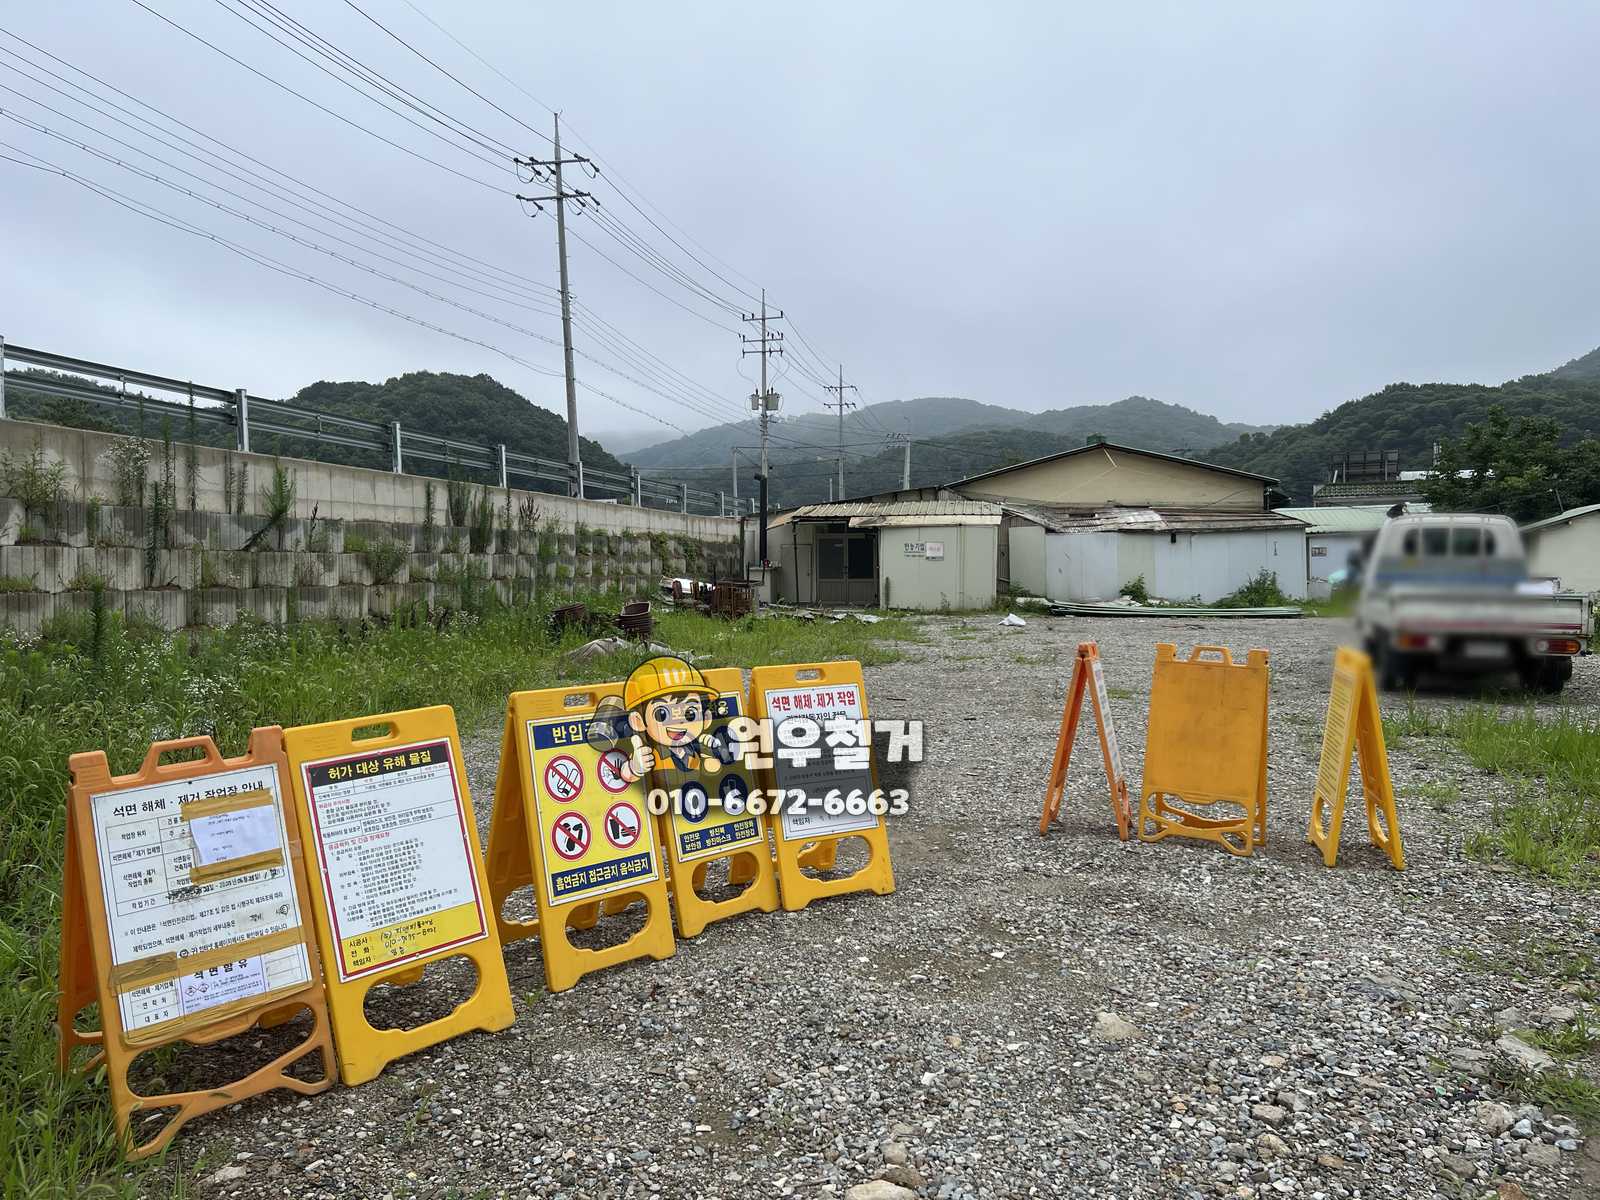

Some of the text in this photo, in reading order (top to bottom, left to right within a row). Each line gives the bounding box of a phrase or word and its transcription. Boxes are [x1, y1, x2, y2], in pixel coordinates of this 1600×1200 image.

[772, 696, 790, 711] 석면
[838, 691, 855, 705] 작업
[327, 764, 352, 780] 허가
[355, 759, 380, 775] 대상
[381, 754, 406, 770] 유해
[408, 749, 431, 765] 물질
[112, 803, 137, 818] 석면
[141, 798, 165, 812] 해체
[555, 856, 648, 891] 흡연금지 접근금지 음식금지
[348, 936, 367, 948] 시공사
